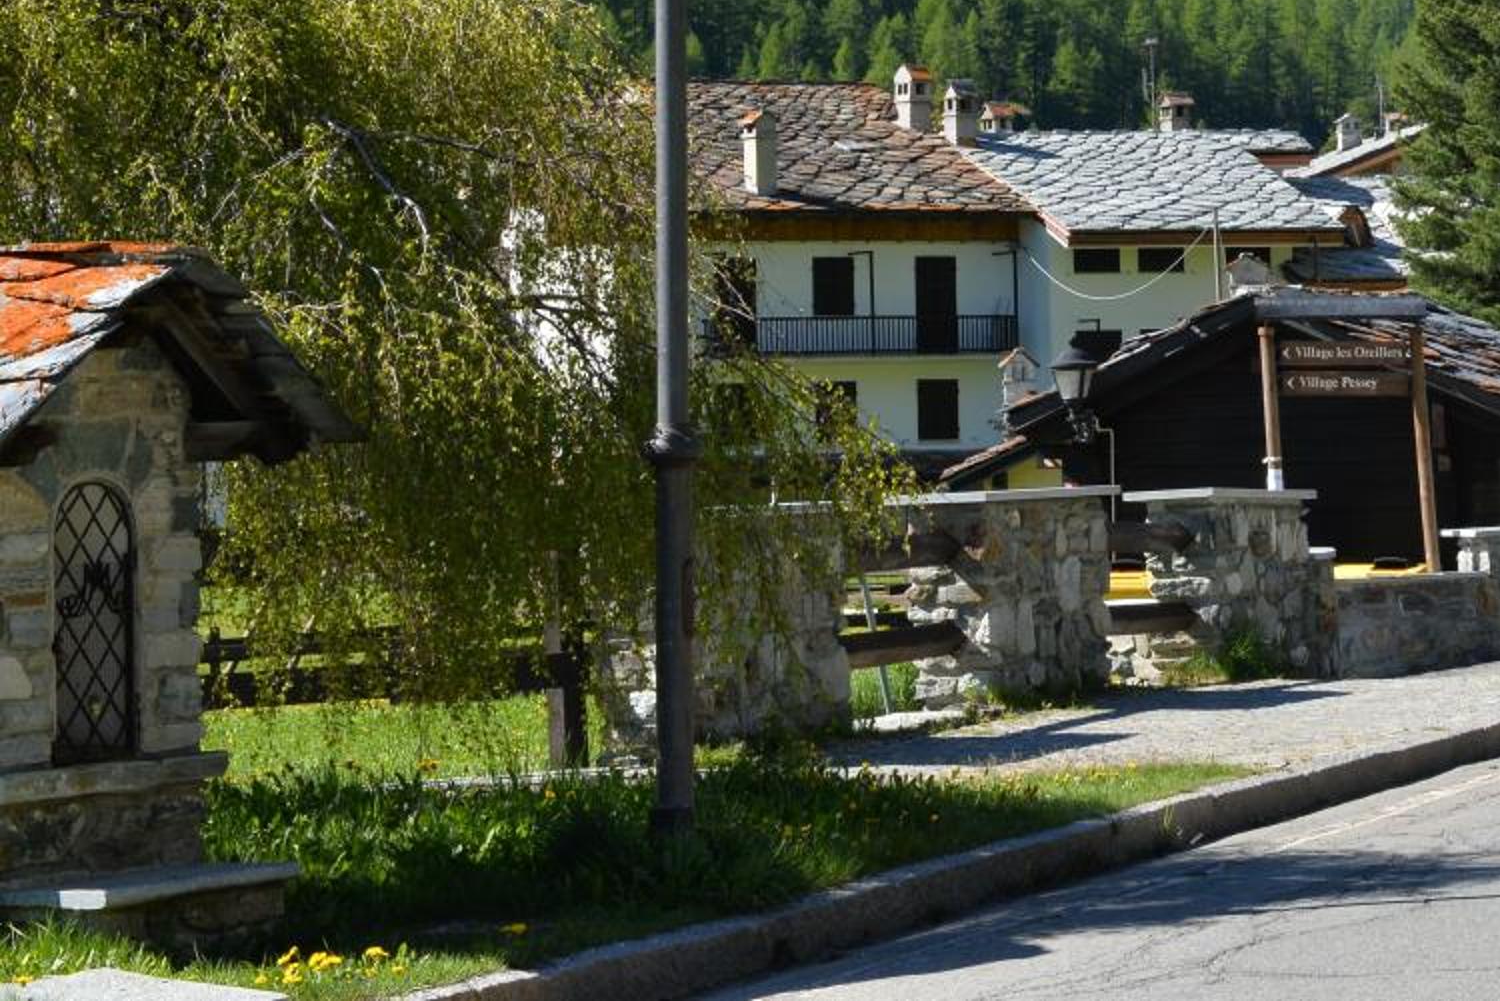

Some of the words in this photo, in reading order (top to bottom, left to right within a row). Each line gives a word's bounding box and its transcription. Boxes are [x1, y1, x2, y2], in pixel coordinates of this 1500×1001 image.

[1295, 346, 1333, 359] Village
[1336, 346, 1351, 358] les
[1299, 376, 1338, 390] Village
